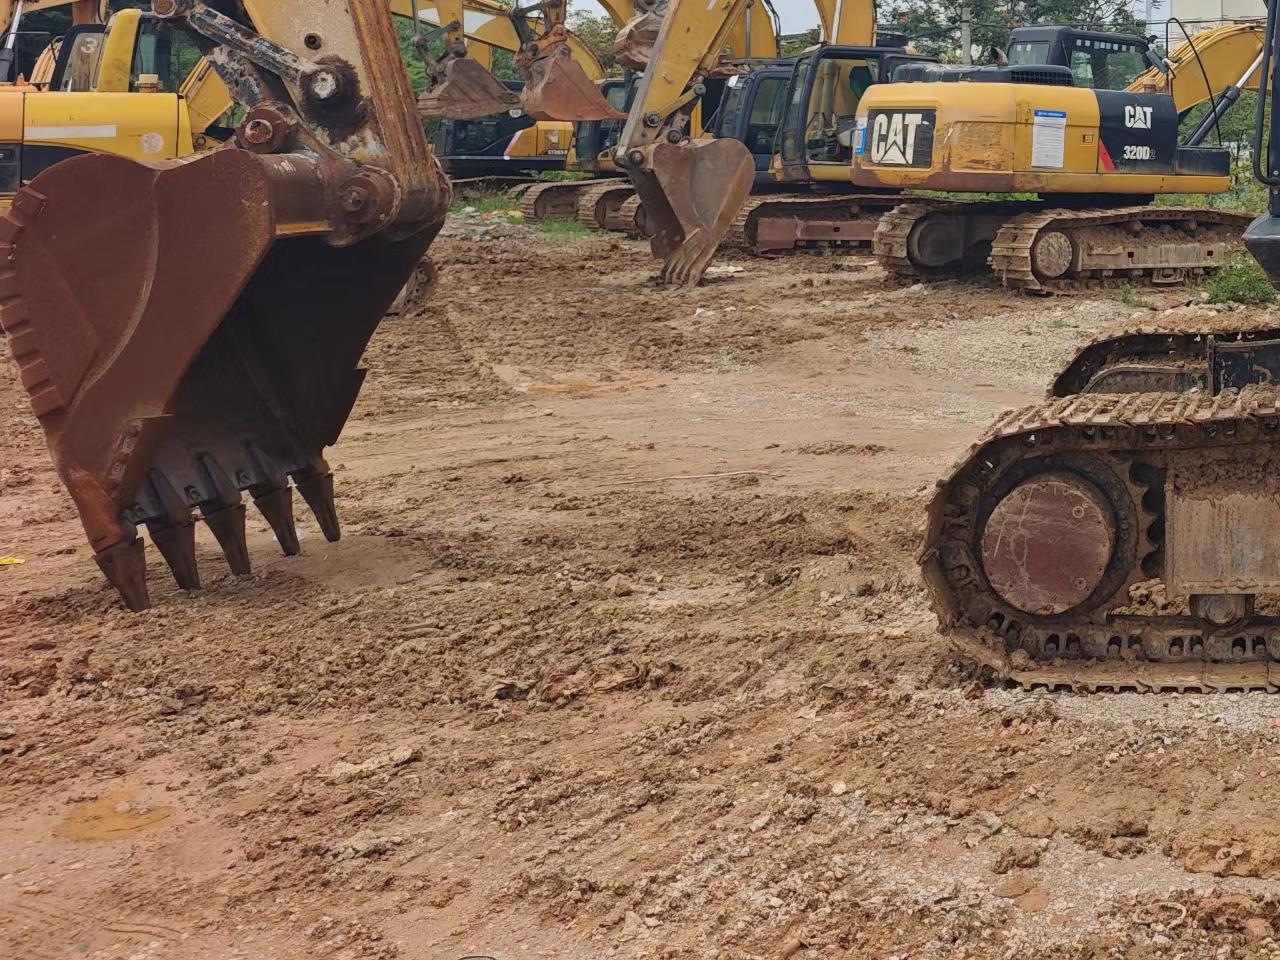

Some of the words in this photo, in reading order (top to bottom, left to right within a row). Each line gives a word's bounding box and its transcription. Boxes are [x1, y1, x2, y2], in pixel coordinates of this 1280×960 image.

[80, 38, 98, 54] 3
[1124, 105, 1153, 130] CAT
[871, 113, 923, 165] CAT
